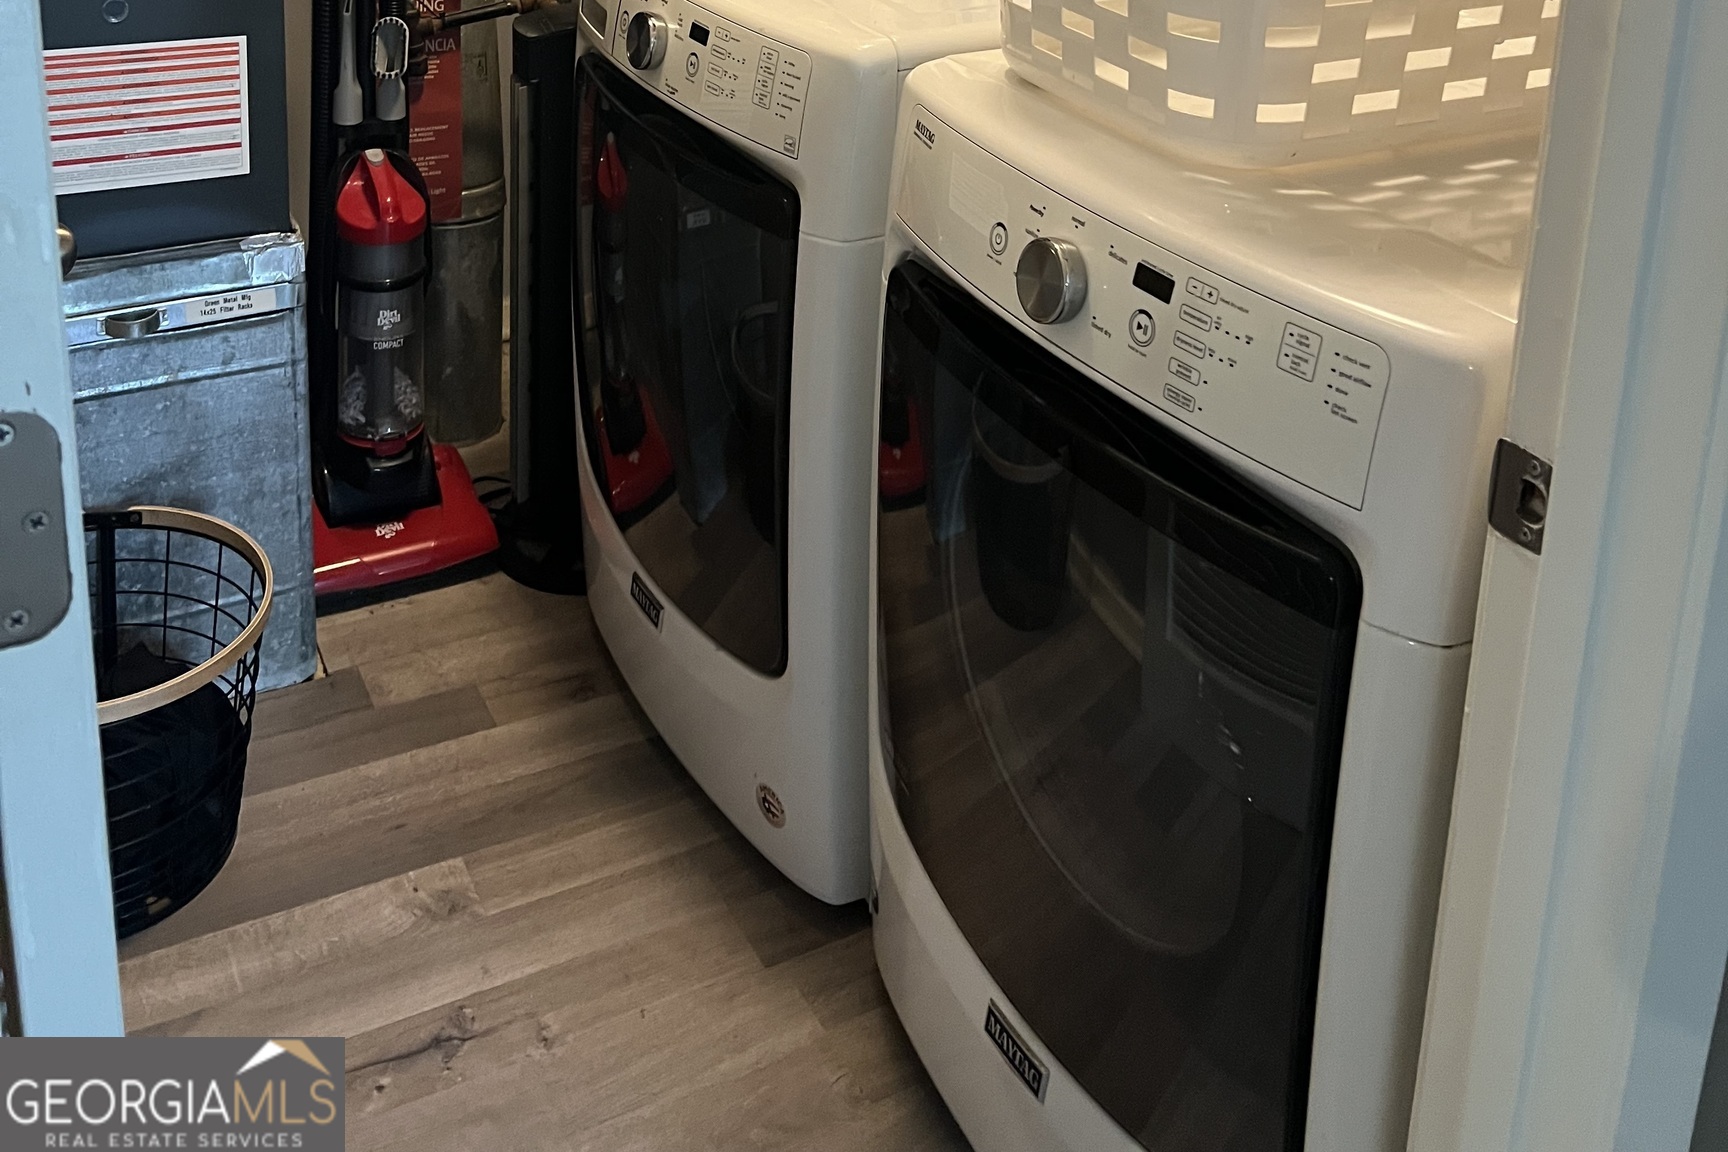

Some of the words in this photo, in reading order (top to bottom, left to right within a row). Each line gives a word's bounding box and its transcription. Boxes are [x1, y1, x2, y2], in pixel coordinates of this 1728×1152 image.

[425, 38, 456, 52] NCIA
[915, 119, 936, 145] MAYTAG
[223, 296, 238, 304] Metal
[377, 314, 401, 326] Devil
[380, 309, 398, 319] Dirt
[373, 339, 404, 350] COMPACT
[632, 582, 659, 624] MAYTAG
[988, 1014, 1040, 1090] MAYTAG
